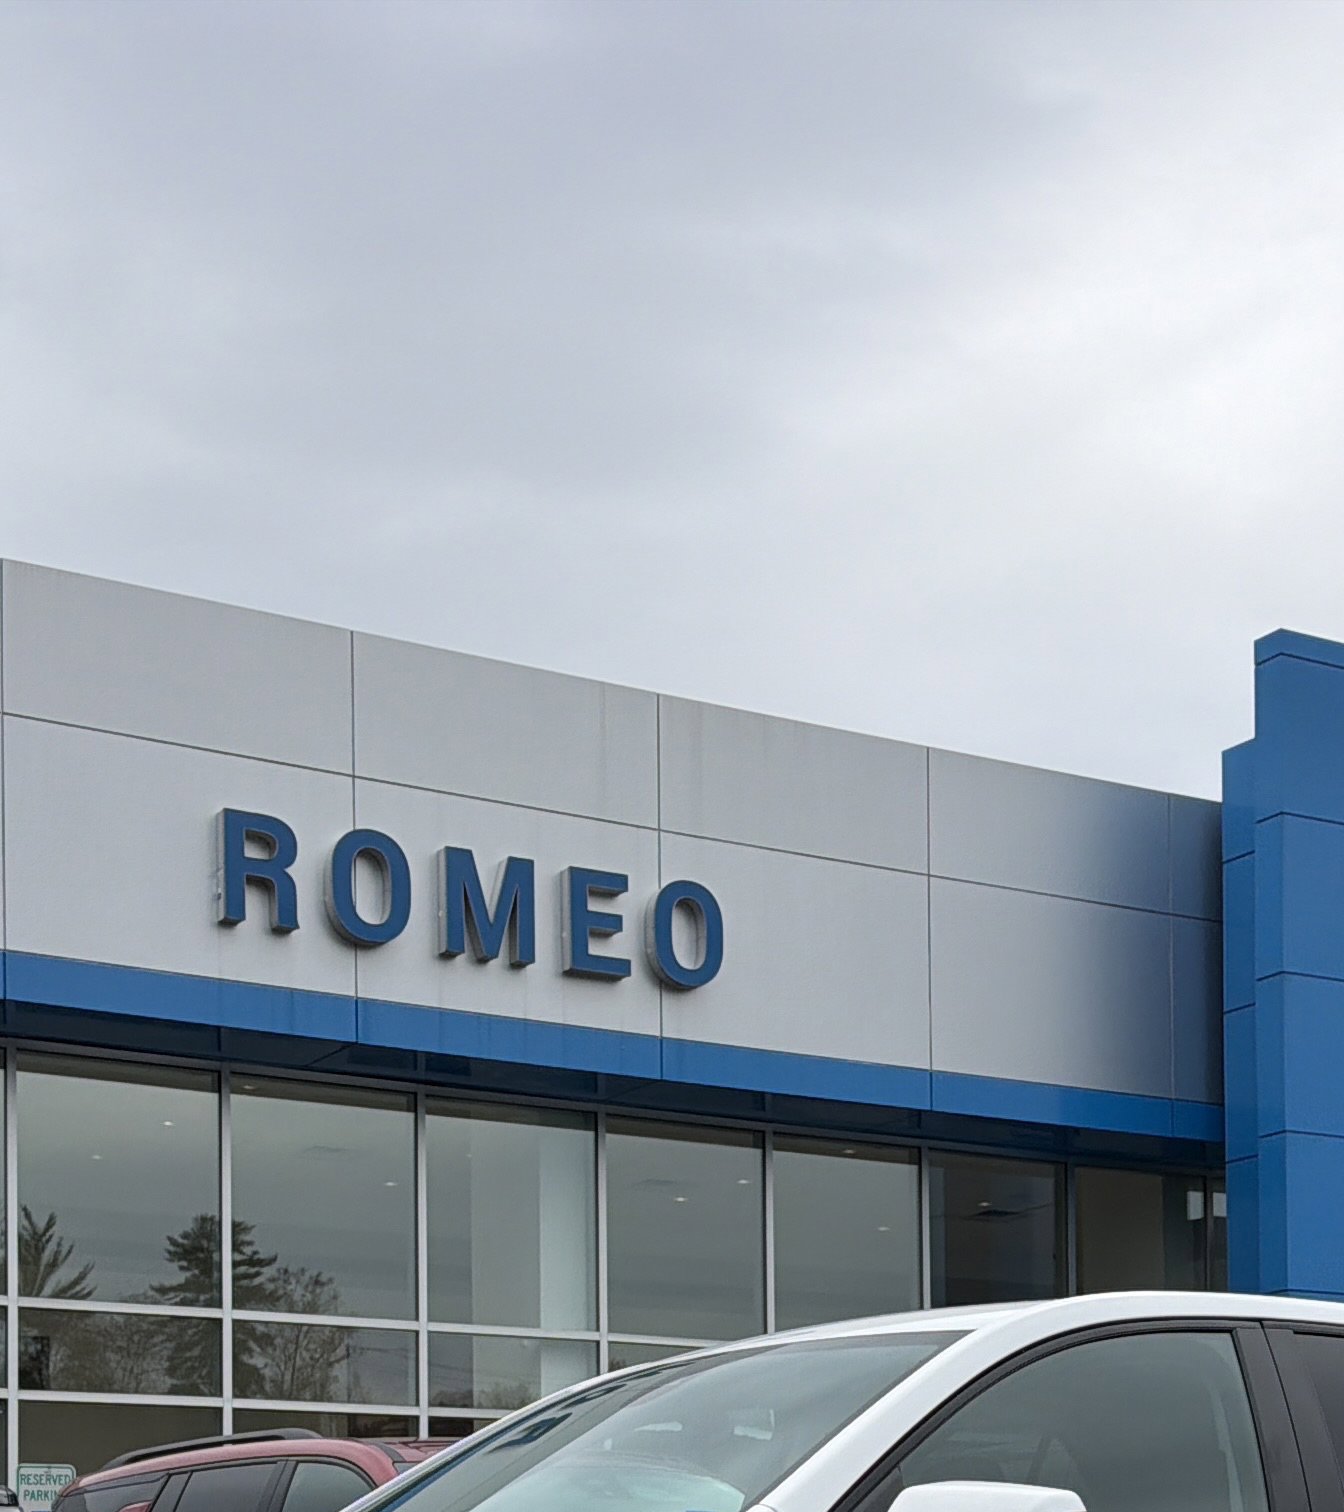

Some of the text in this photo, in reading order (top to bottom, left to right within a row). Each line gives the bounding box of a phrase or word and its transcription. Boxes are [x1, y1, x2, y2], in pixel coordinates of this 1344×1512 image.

[216, 807, 724, 990] ROMEO
[20, 1473, 71, 1486] RESERVED
[23, 1489, 58, 1501] PARKI
